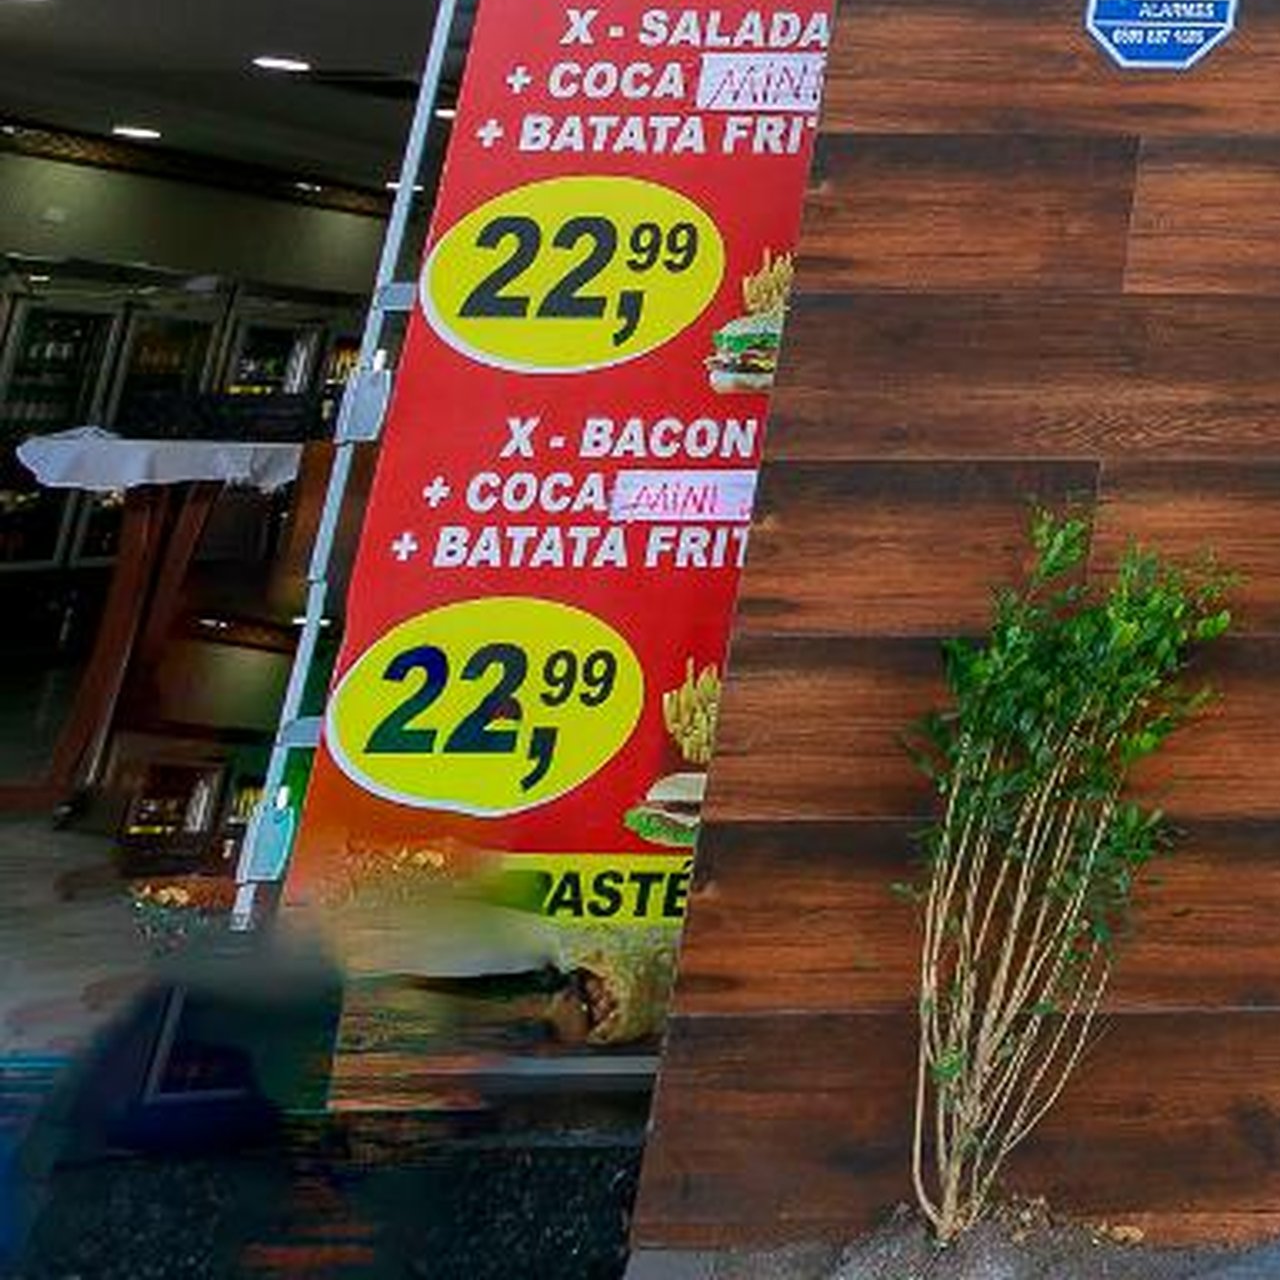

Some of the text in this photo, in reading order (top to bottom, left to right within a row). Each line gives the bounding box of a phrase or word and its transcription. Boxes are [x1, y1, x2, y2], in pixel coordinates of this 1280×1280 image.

[560, 9, 599, 46] X
[638, 10, 830, 48] SALADA
[1139, 2, 1215, 18] ALARMES
[547, 61, 686, 100] COCA
[517, 116, 708, 154] BATATA
[721, 116, 818, 154] FRI
[500, 416, 541, 459] X
[580, 418, 758, 460] BACON
[465, 472, 612, 513] COCA
[432, 528, 629, 568] BATATA
